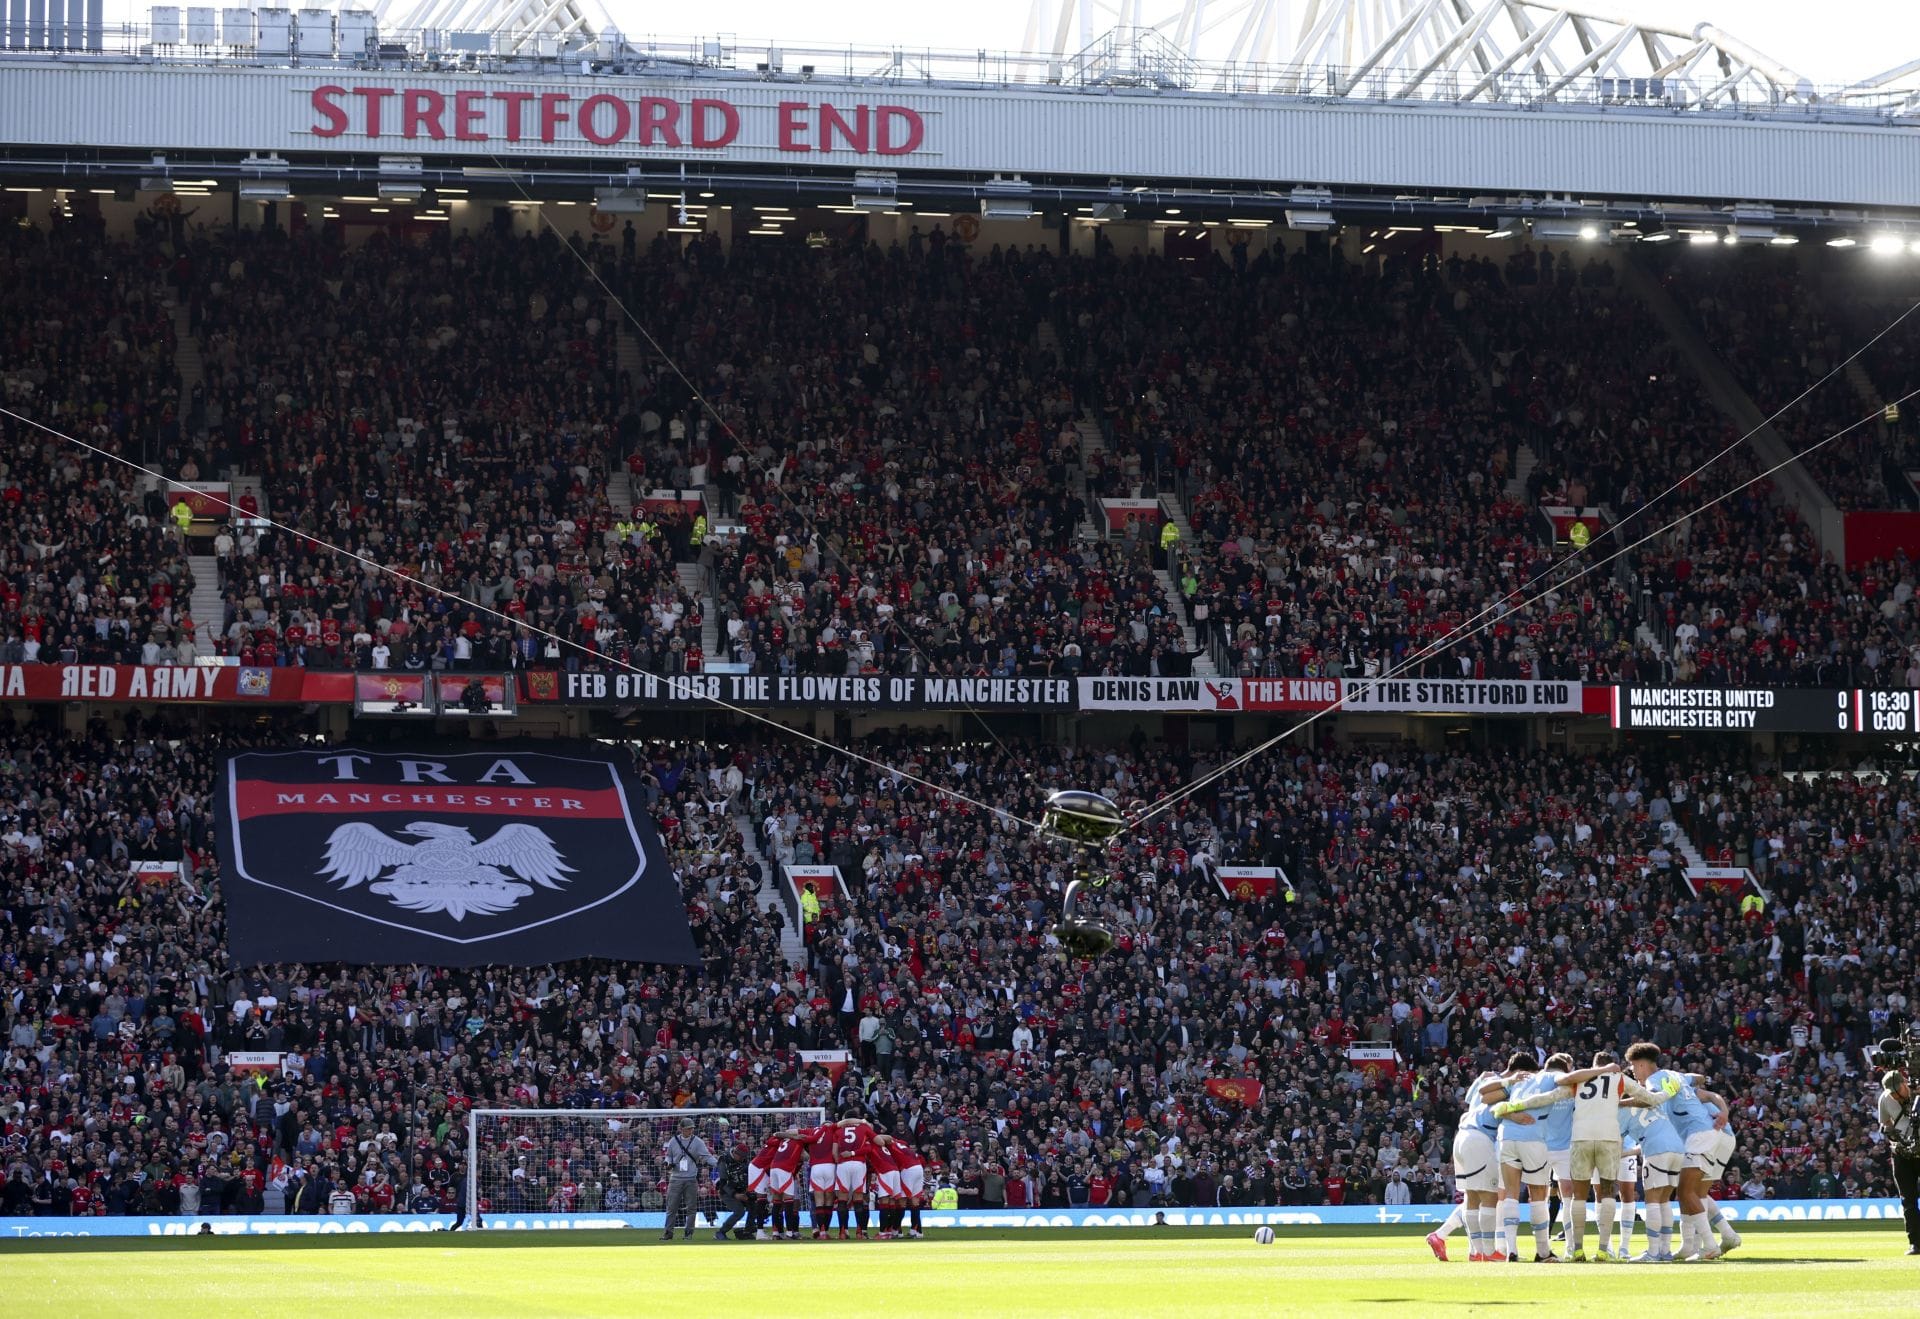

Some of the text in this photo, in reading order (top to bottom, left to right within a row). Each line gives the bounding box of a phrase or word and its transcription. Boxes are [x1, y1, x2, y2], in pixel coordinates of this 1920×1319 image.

[311, 85, 925, 155] STRETFORD END
[567, 673, 1070, 703] FEB 6TH 1958 THE FLOWERS OF MANCHESTER
[1092, 680, 1569, 705] DENIS LAW THE KING OF THE STRETFORD END
[1630, 688, 1848, 709] MANCHESTER UNITED 0
[1869, 691, 1910, 711] 16:30
[1630, 709, 1848, 730] MANCHESTER CITY 0
[1872, 711, 1907, 730] 0:00
[317, 755, 536, 785] TRA
[276, 793, 587, 811] MANCHESTER
[1579, 1075, 1610, 1100] 31
[844, 1126, 857, 1144] 5
